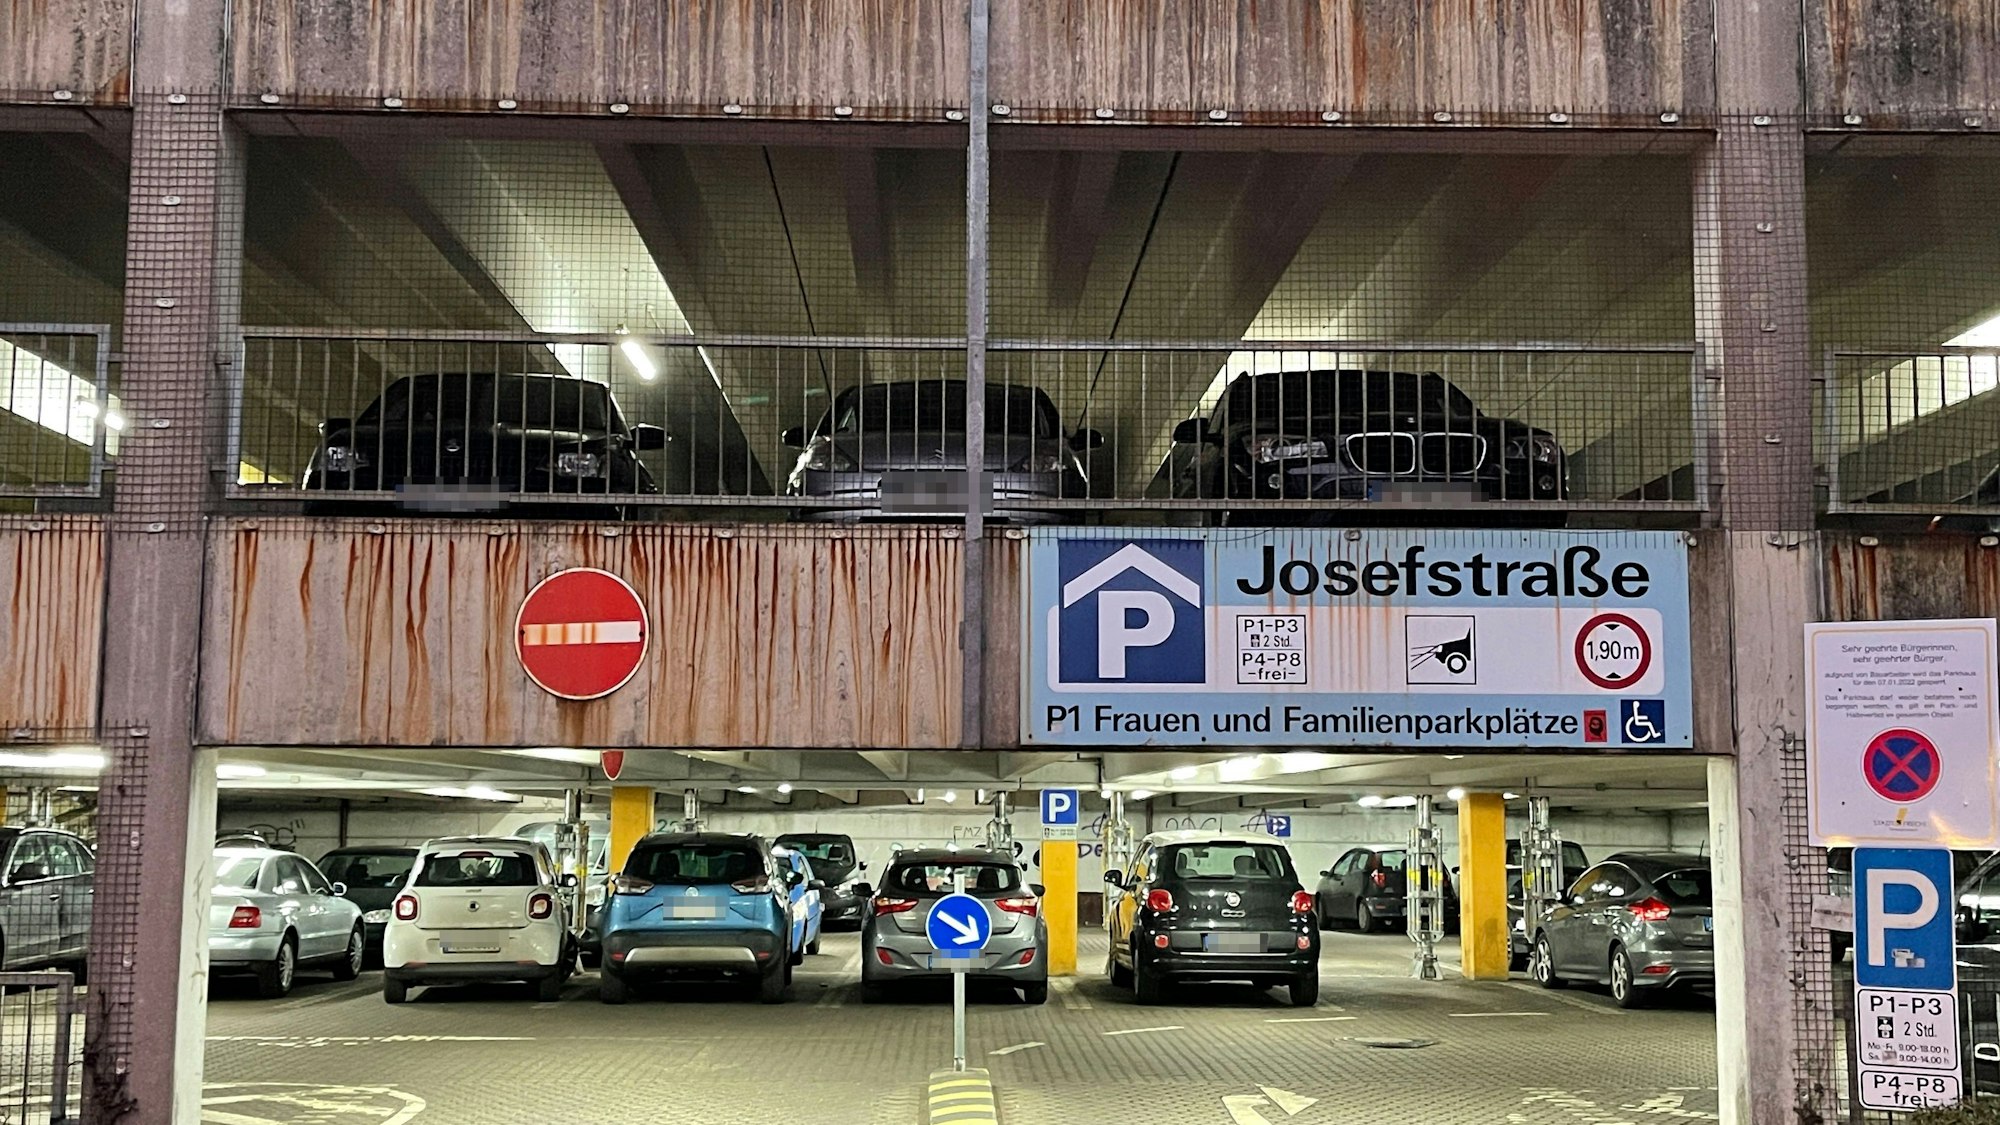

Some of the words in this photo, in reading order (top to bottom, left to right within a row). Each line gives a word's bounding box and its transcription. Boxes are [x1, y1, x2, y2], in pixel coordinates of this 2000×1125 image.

[1236, 545, 1650, 598] Josefstraße
[1098, 590, 1175, 679] P
[1244, 619, 1299, 633] P1-P3
[1263, 635, 1270, 647] 2
[1273, 635, 1292, 647] Std.
[1242, 652, 1301, 667] P4-P8
[1047, 706, 1080, 732] P1
[1095, 706, 1200, 733] Frauen
[1213, 706, 1271, 733] und
[1283, 705, 1578, 741] Familienparkplätze
[1049, 793, 1071, 822] P
[1866, 868, 1939, 967] P
[1869, 995, 1942, 1016] P1-P3
[1904, 1021, 1911, 1036] 2
[1915, 1022, 1938, 1038] Std.
[1874, 1075, 1945, 1093] P4-P8
